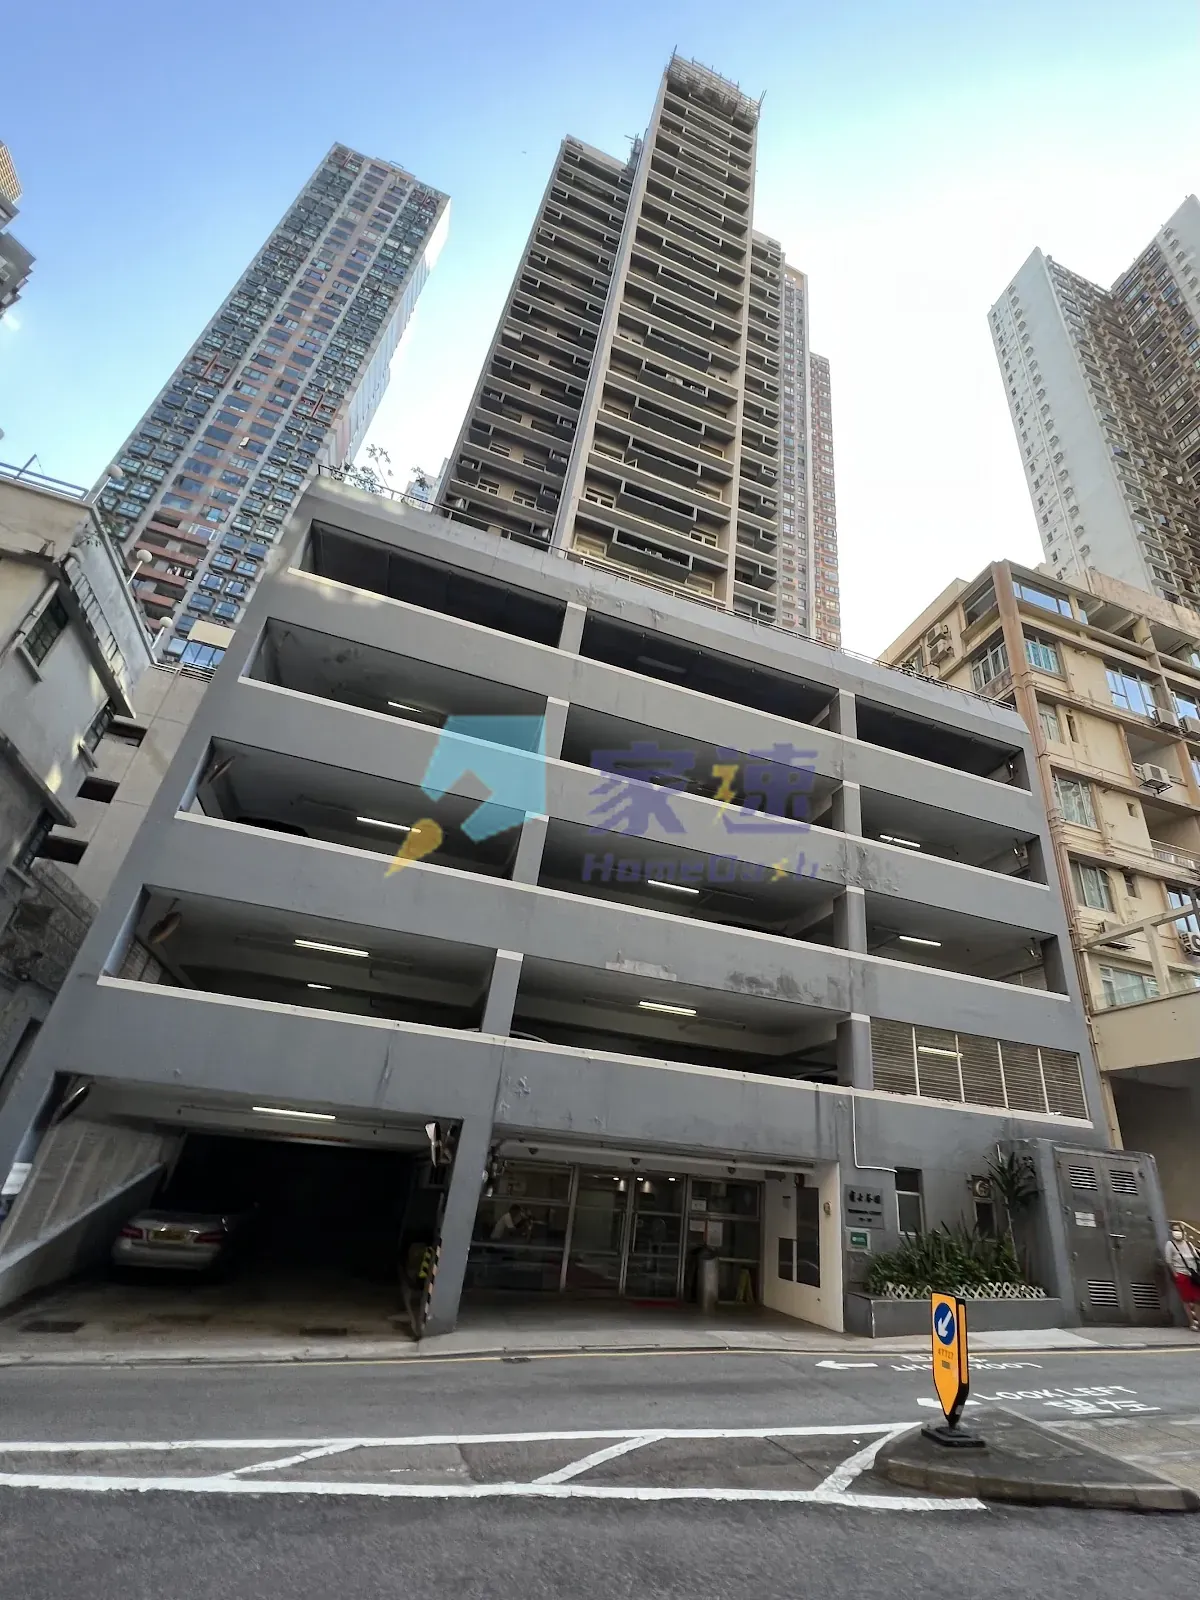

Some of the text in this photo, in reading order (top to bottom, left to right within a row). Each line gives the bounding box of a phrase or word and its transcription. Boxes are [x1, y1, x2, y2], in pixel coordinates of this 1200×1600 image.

[973, 1385, 1137, 1400] LOOK LEFT
[1043, 1398, 1161, 1414] 望左
